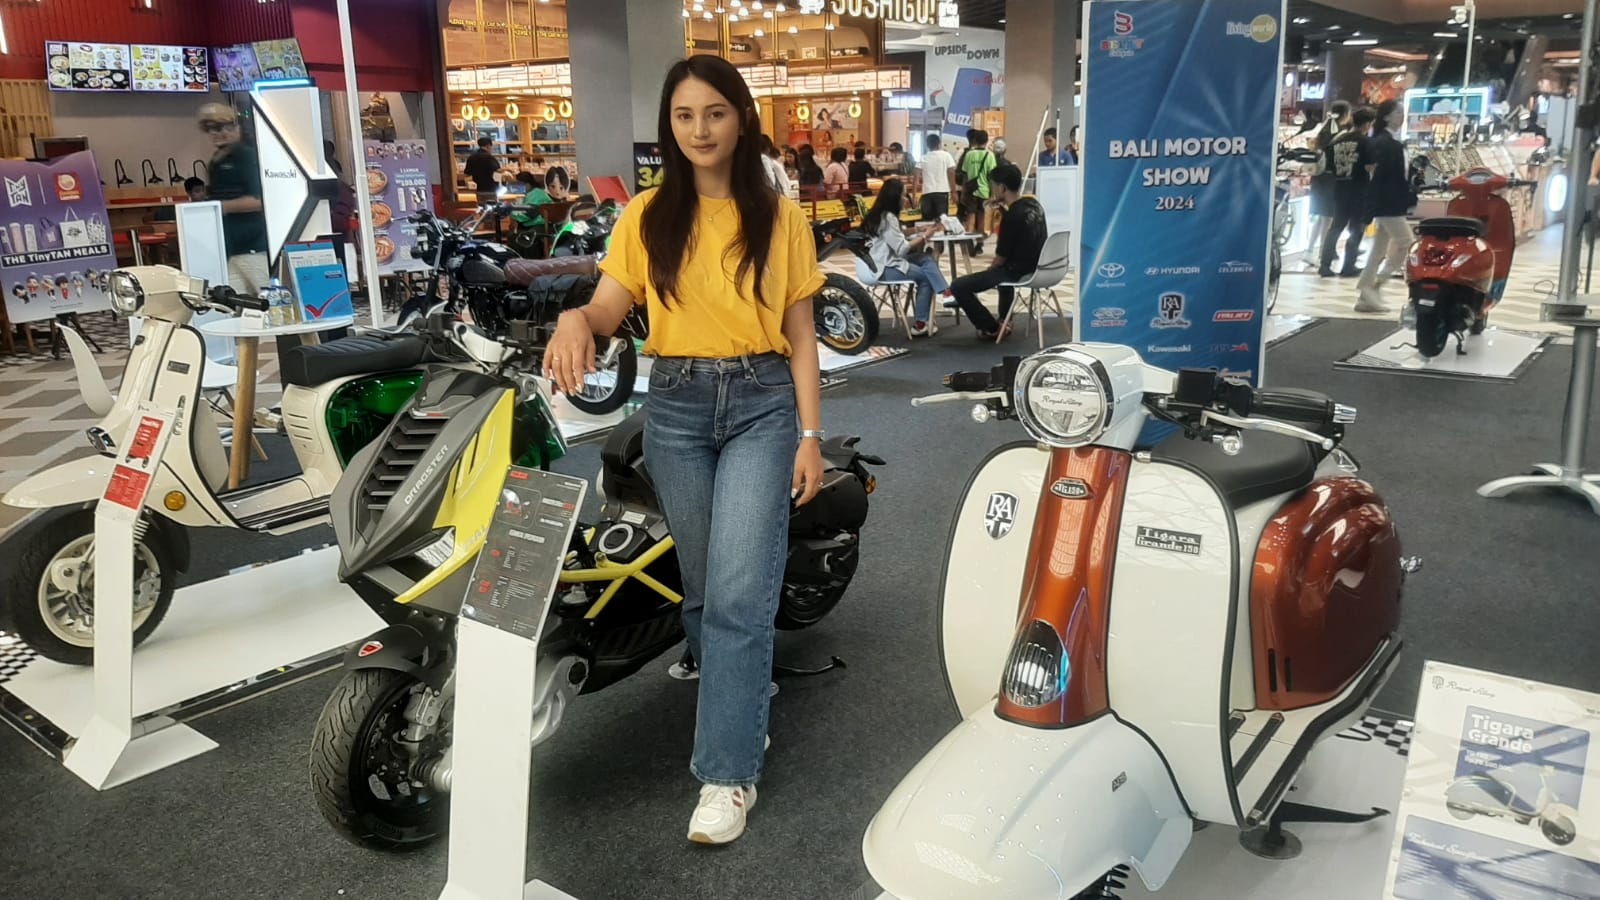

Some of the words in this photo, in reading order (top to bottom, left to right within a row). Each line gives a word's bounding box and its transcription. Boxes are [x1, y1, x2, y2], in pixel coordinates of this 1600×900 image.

[934, 45, 967, 56] UPSIDE
[967, 48, 1000, 60] DOWN
[1109, 139, 1157, 158] BALI
[1165, 137, 1247, 156] MOTOR
[637, 156, 664, 165] VALU
[264, 168, 297, 179] Kawasaki
[1143, 167, 1210, 186] SHOW
[1155, 196, 1195, 210] 2024
[4, 255, 26, 265] THE
[28, 250, 71, 262] TinyTAN
[73, 245, 108, 257] MEALS
[1147, 344, 1191, 352] Kawasaki
[404, 444, 449, 505] DRAGSTER
[988, 495, 1013, 520] RA
[1136, 536, 1183, 551] Grande
[1183, 544, 1199, 554] 150
[1142, 528, 1199, 545] Tigara
[1471, 713, 1534, 740] Tigara
[1468, 728, 1533, 754] Grande
